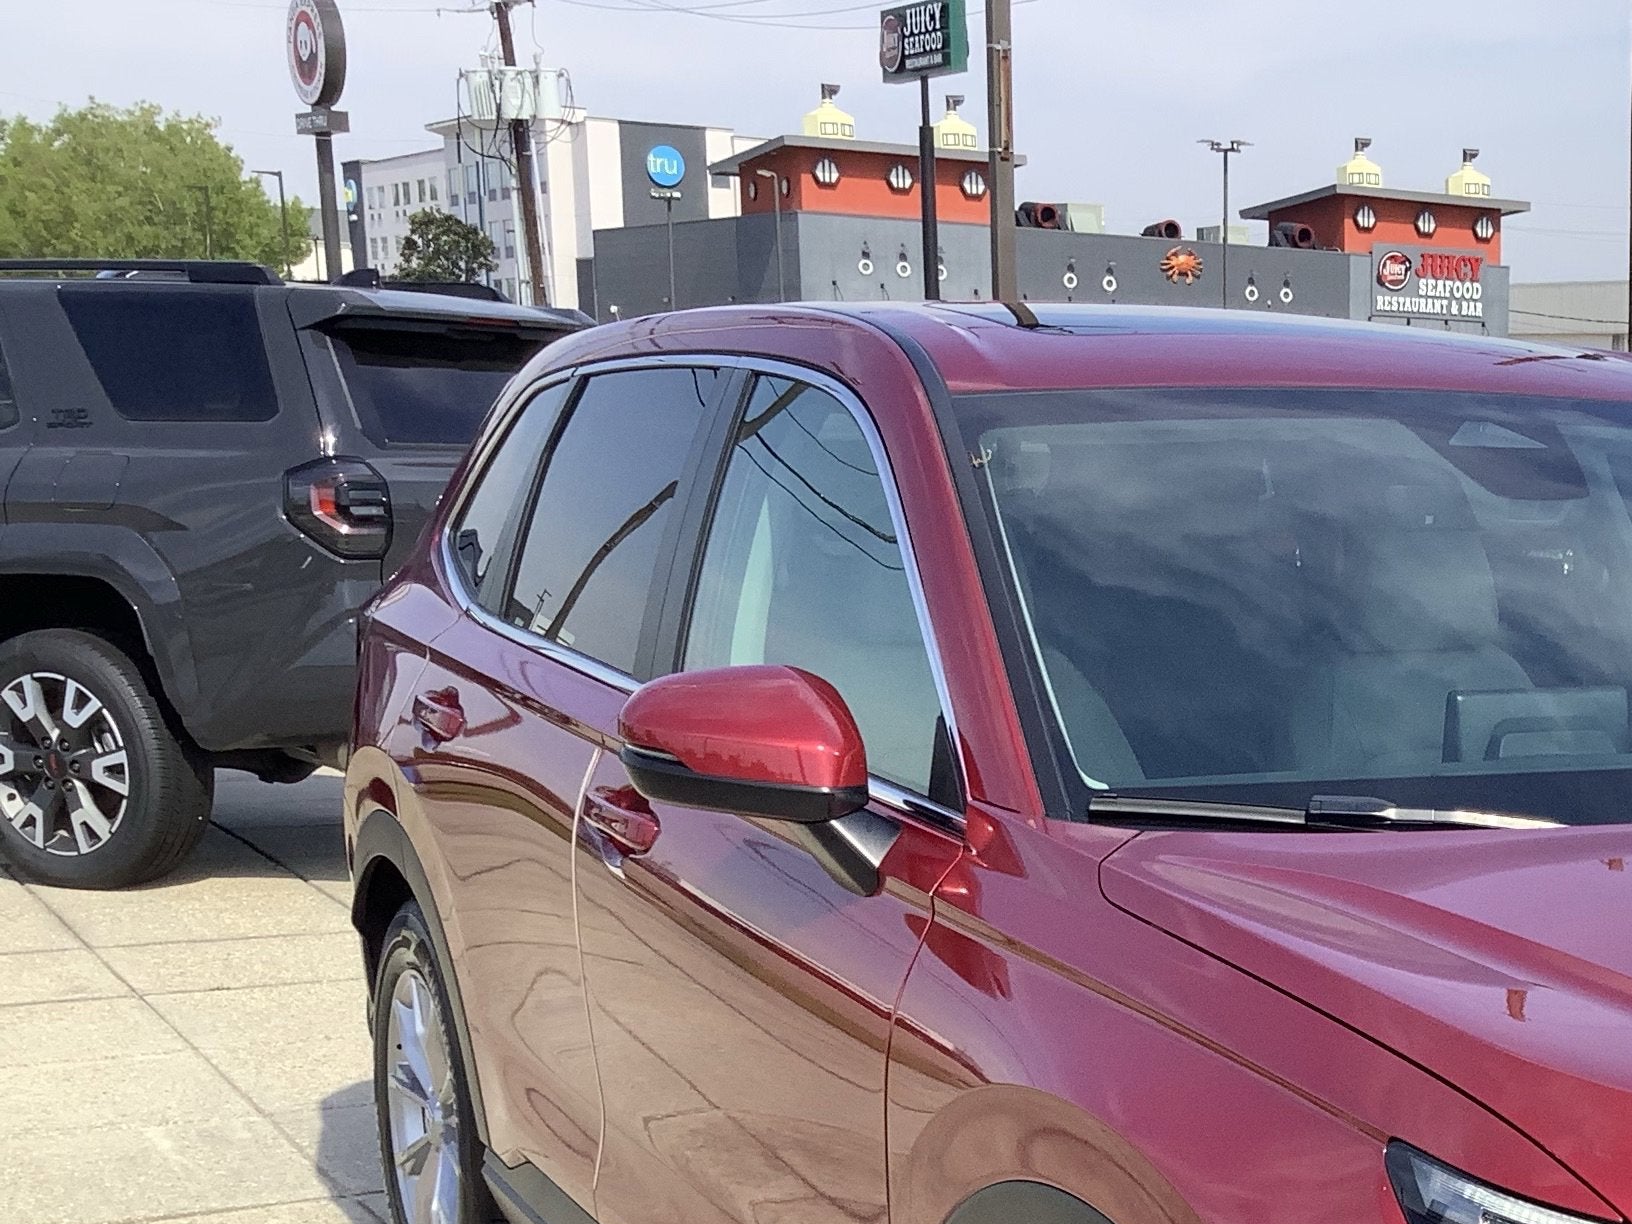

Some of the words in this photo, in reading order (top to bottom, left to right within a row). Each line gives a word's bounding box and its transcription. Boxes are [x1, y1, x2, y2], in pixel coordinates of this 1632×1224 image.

[903, 2, 942, 36] JUICY
[904, 31, 943, 55] SEAFOOD
[647, 152, 678, 175] tru
[1415, 253, 1483, 281] JUICY
[1418, 279, 1482, 299] SEAFOOD
[1376, 296, 1448, 314] RESTAURANT
[1450, 300, 1459, 315] &
[1461, 301, 1483, 317] BAR
